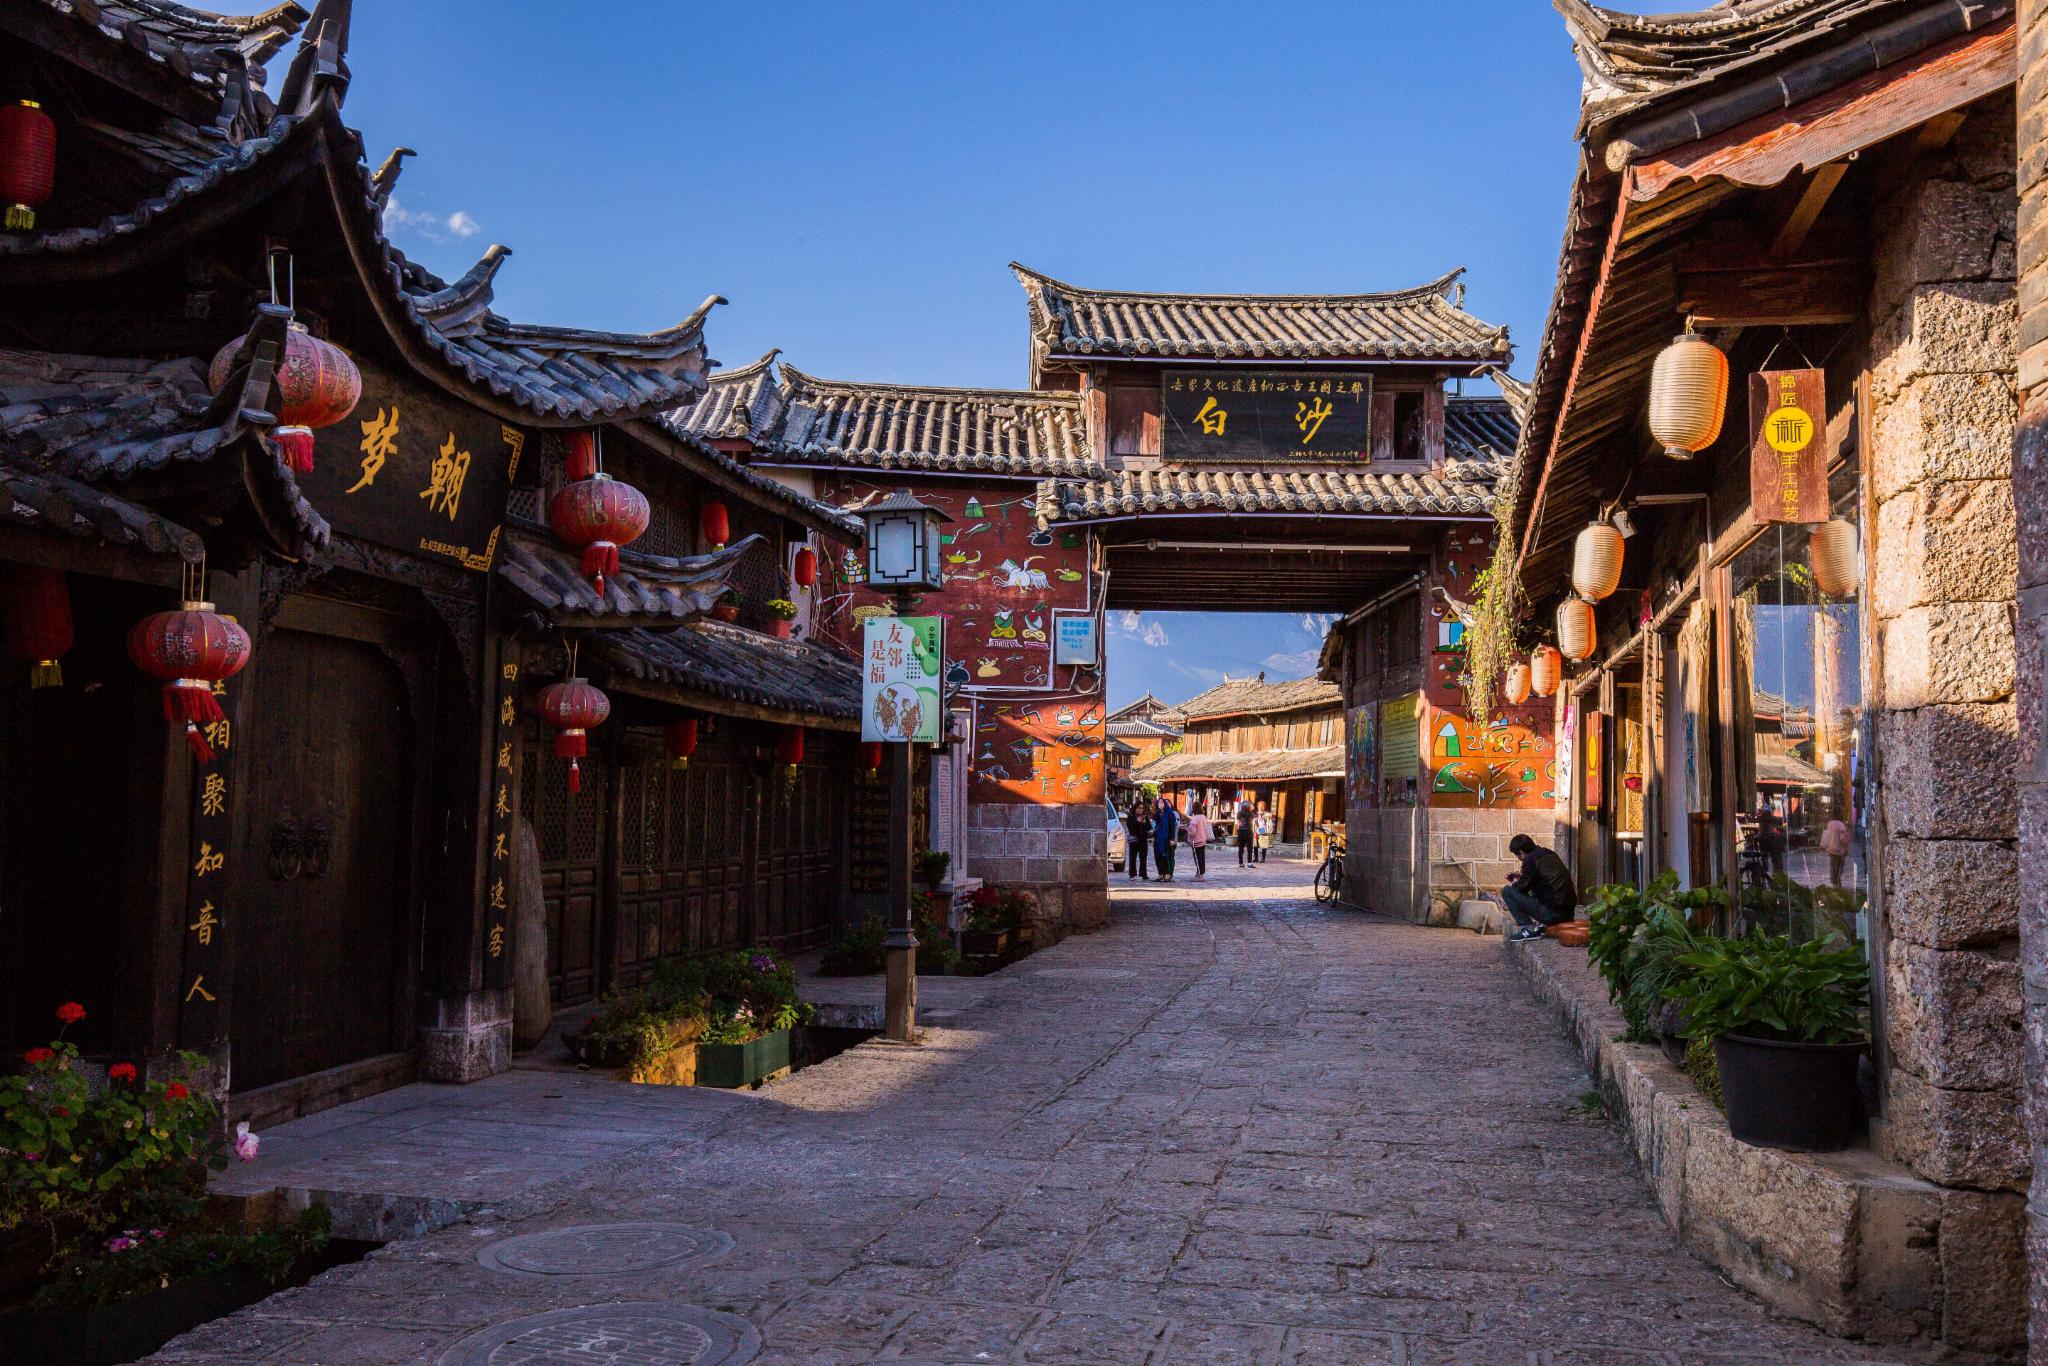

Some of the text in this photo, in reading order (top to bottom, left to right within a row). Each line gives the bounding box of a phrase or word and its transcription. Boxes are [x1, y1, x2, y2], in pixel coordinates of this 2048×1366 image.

[1191, 396, 1333, 445] 白沙
[1781, 454, 1799, 519] 手工皮艺
[870, 640, 886, 684] 是福
[887, 623, 903, 668] 友邻
[186, 614, 238, 1003] 相聚知音人
